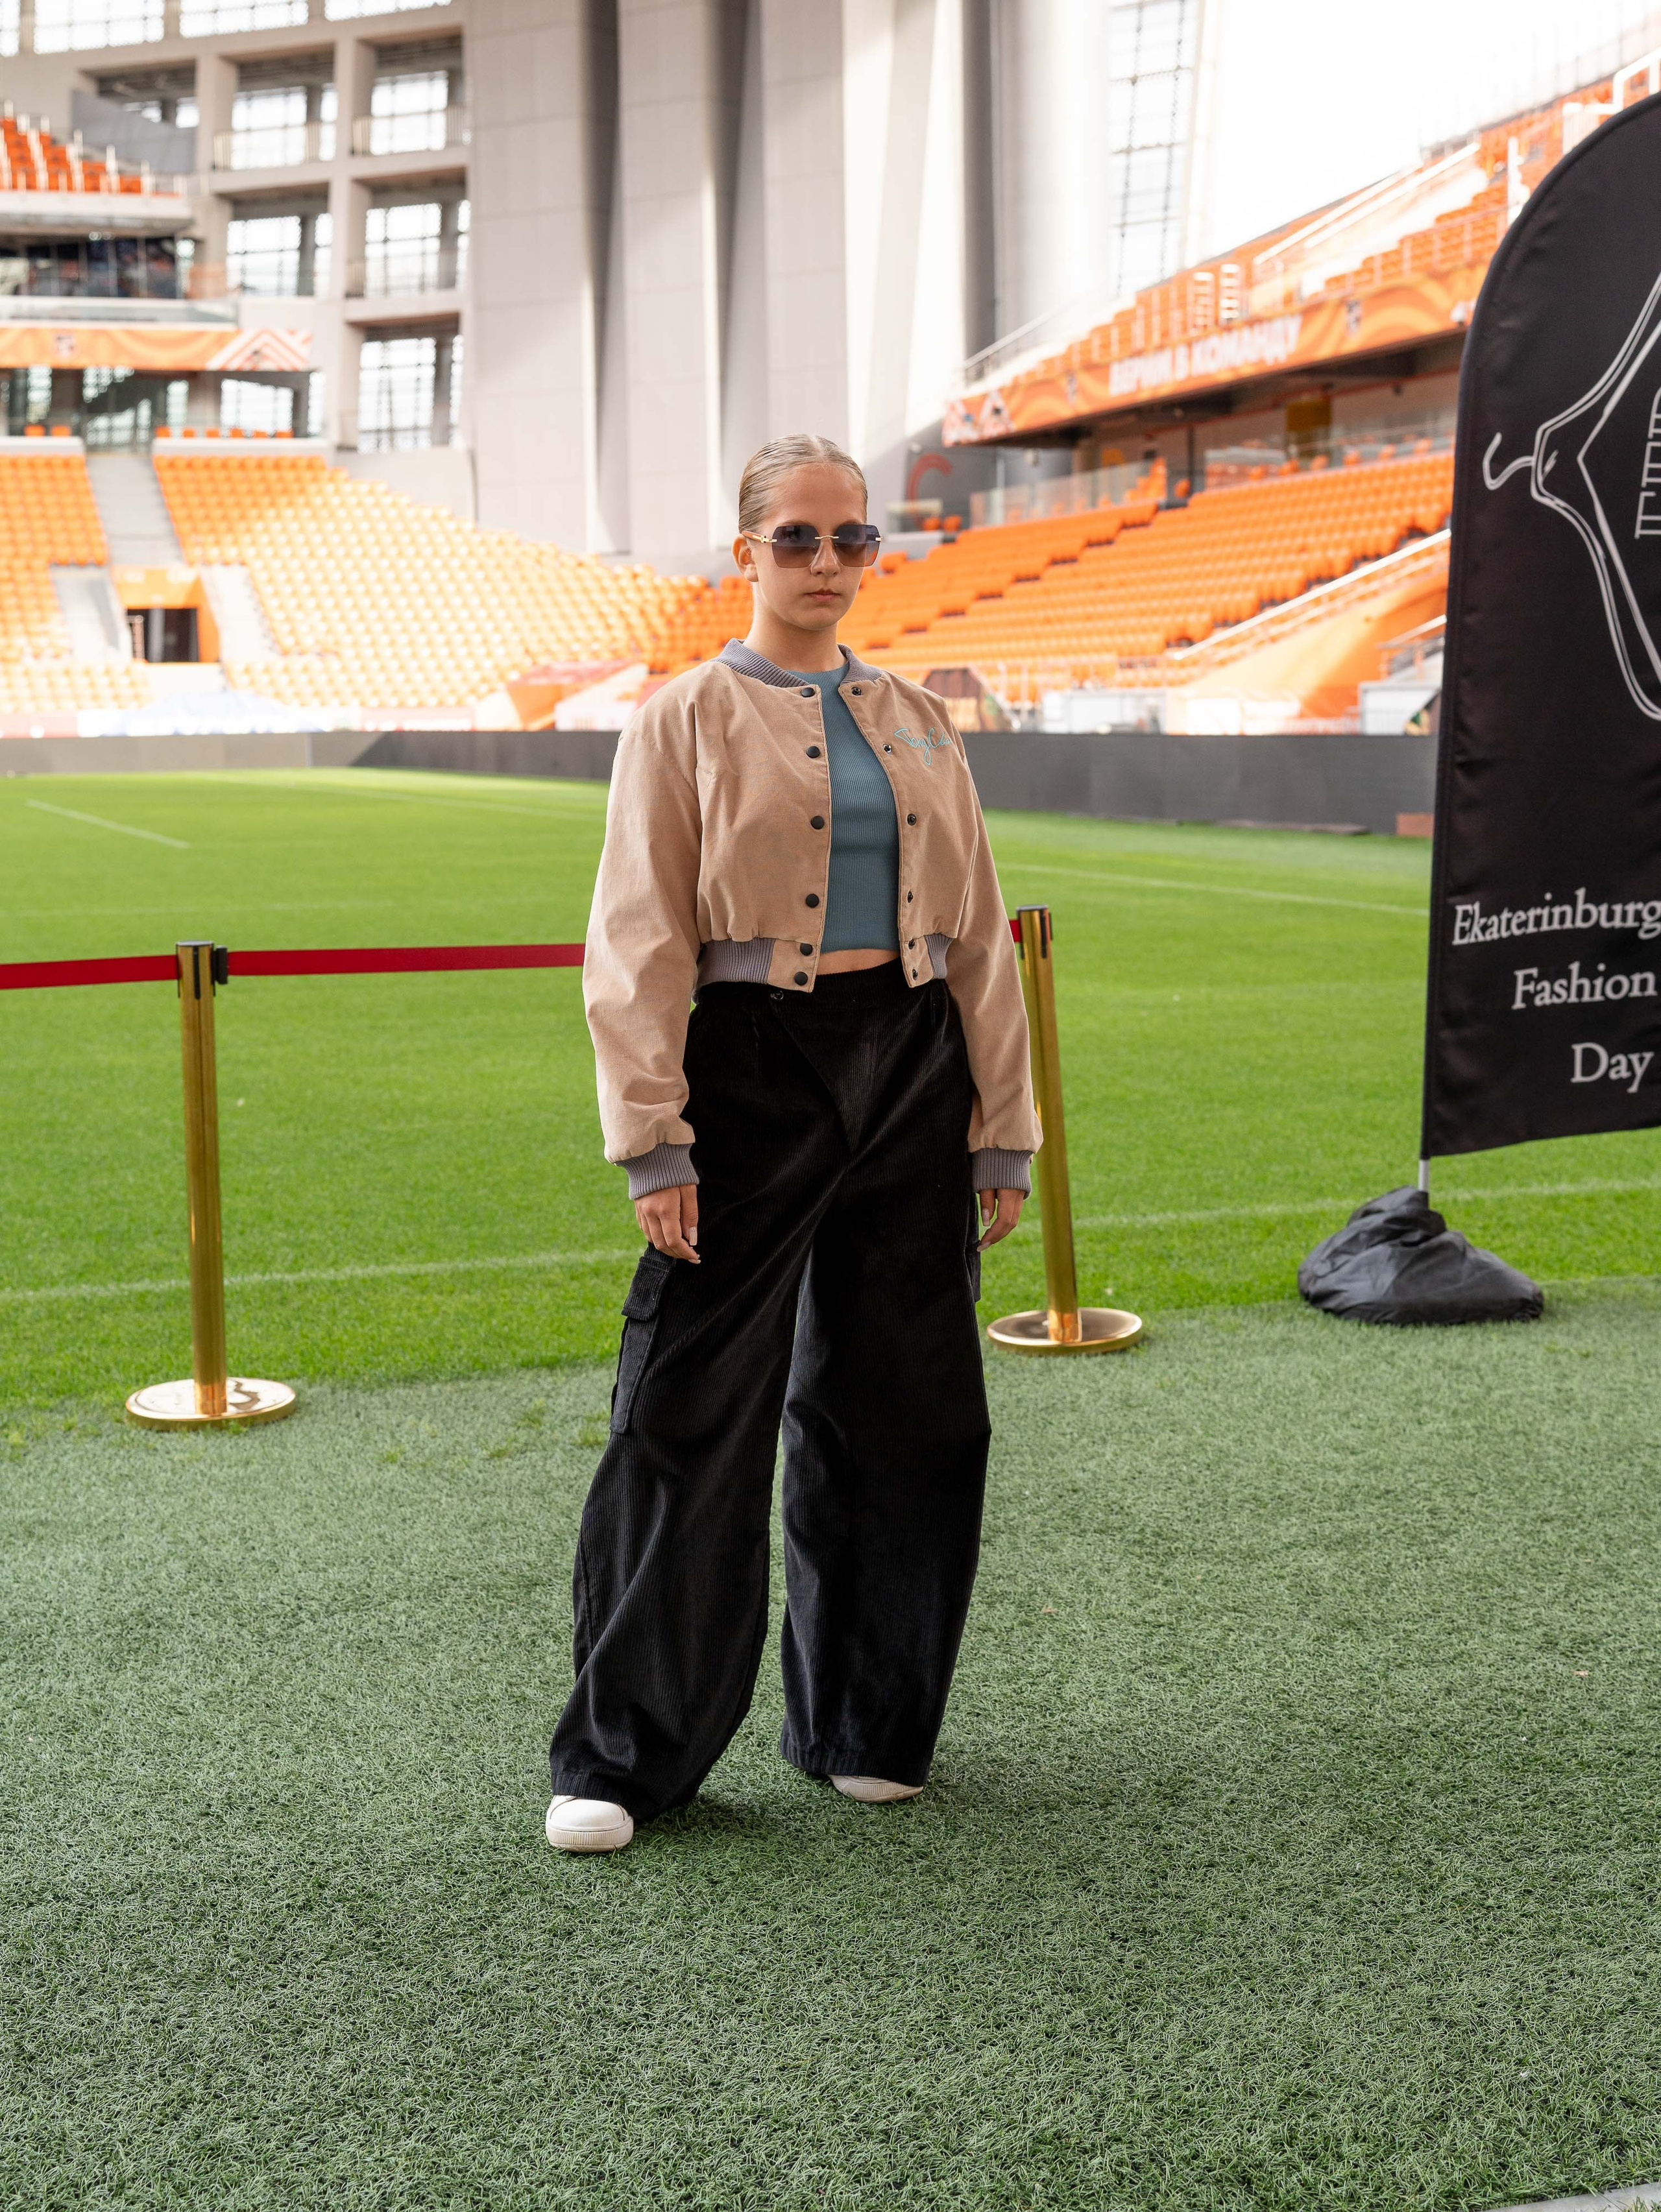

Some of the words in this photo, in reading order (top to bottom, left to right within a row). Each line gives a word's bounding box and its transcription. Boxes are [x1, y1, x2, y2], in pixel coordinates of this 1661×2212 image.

[1451, 887, 1661, 946] Ekaterinburg
[1511, 961, 1658, 1010] Fashion
[1570, 1042, 1655, 1094] Day
